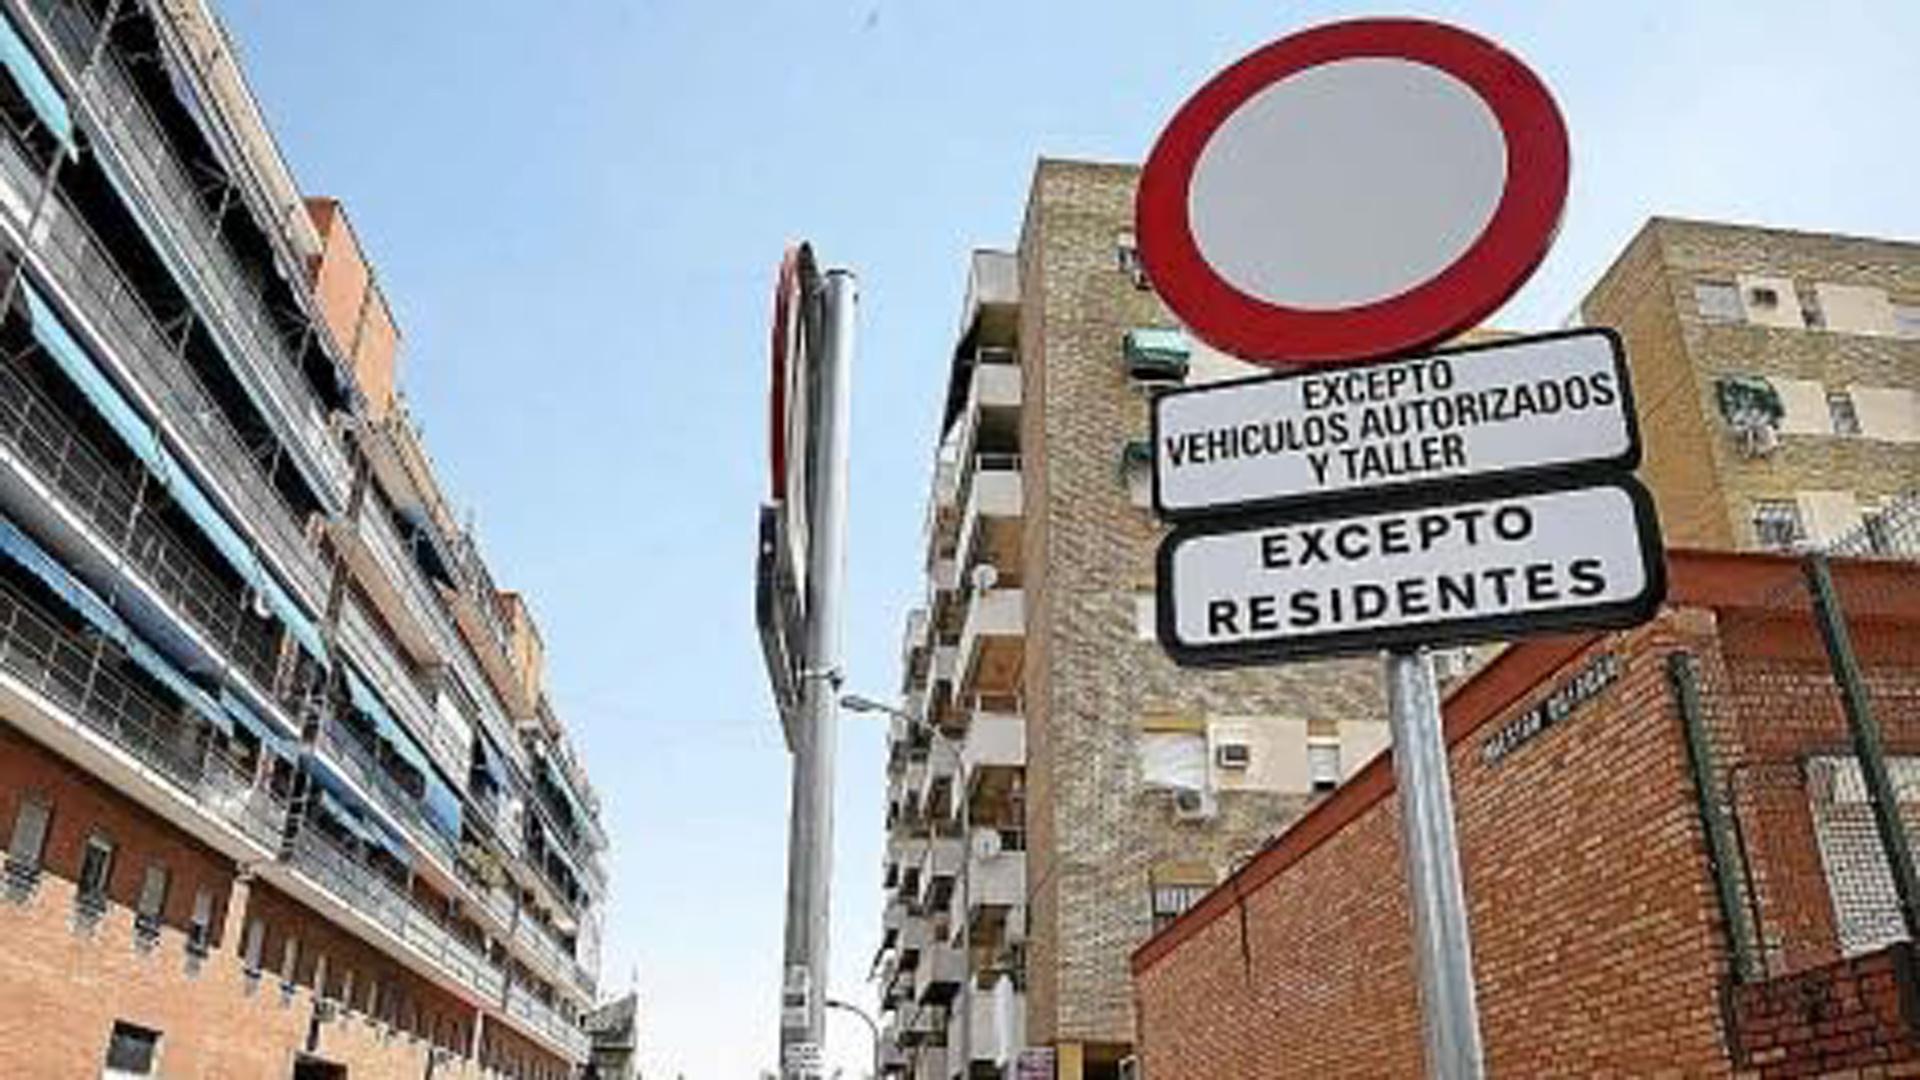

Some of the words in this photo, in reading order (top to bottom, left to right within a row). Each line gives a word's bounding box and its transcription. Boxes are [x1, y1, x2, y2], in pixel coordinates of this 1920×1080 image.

[1302, 361, 1452, 409] EXCEPTO
[1166, 412, 1348, 467] VEHICULOS
[1359, 372, 1615, 439] AUTORIZADOS
[1308, 452, 1332, 485] Y
[1342, 434, 1466, 481] TALLER
[1262, 507, 1533, 568] EXCEPTO
[1208, 560, 1606, 635] RESIDENTES
